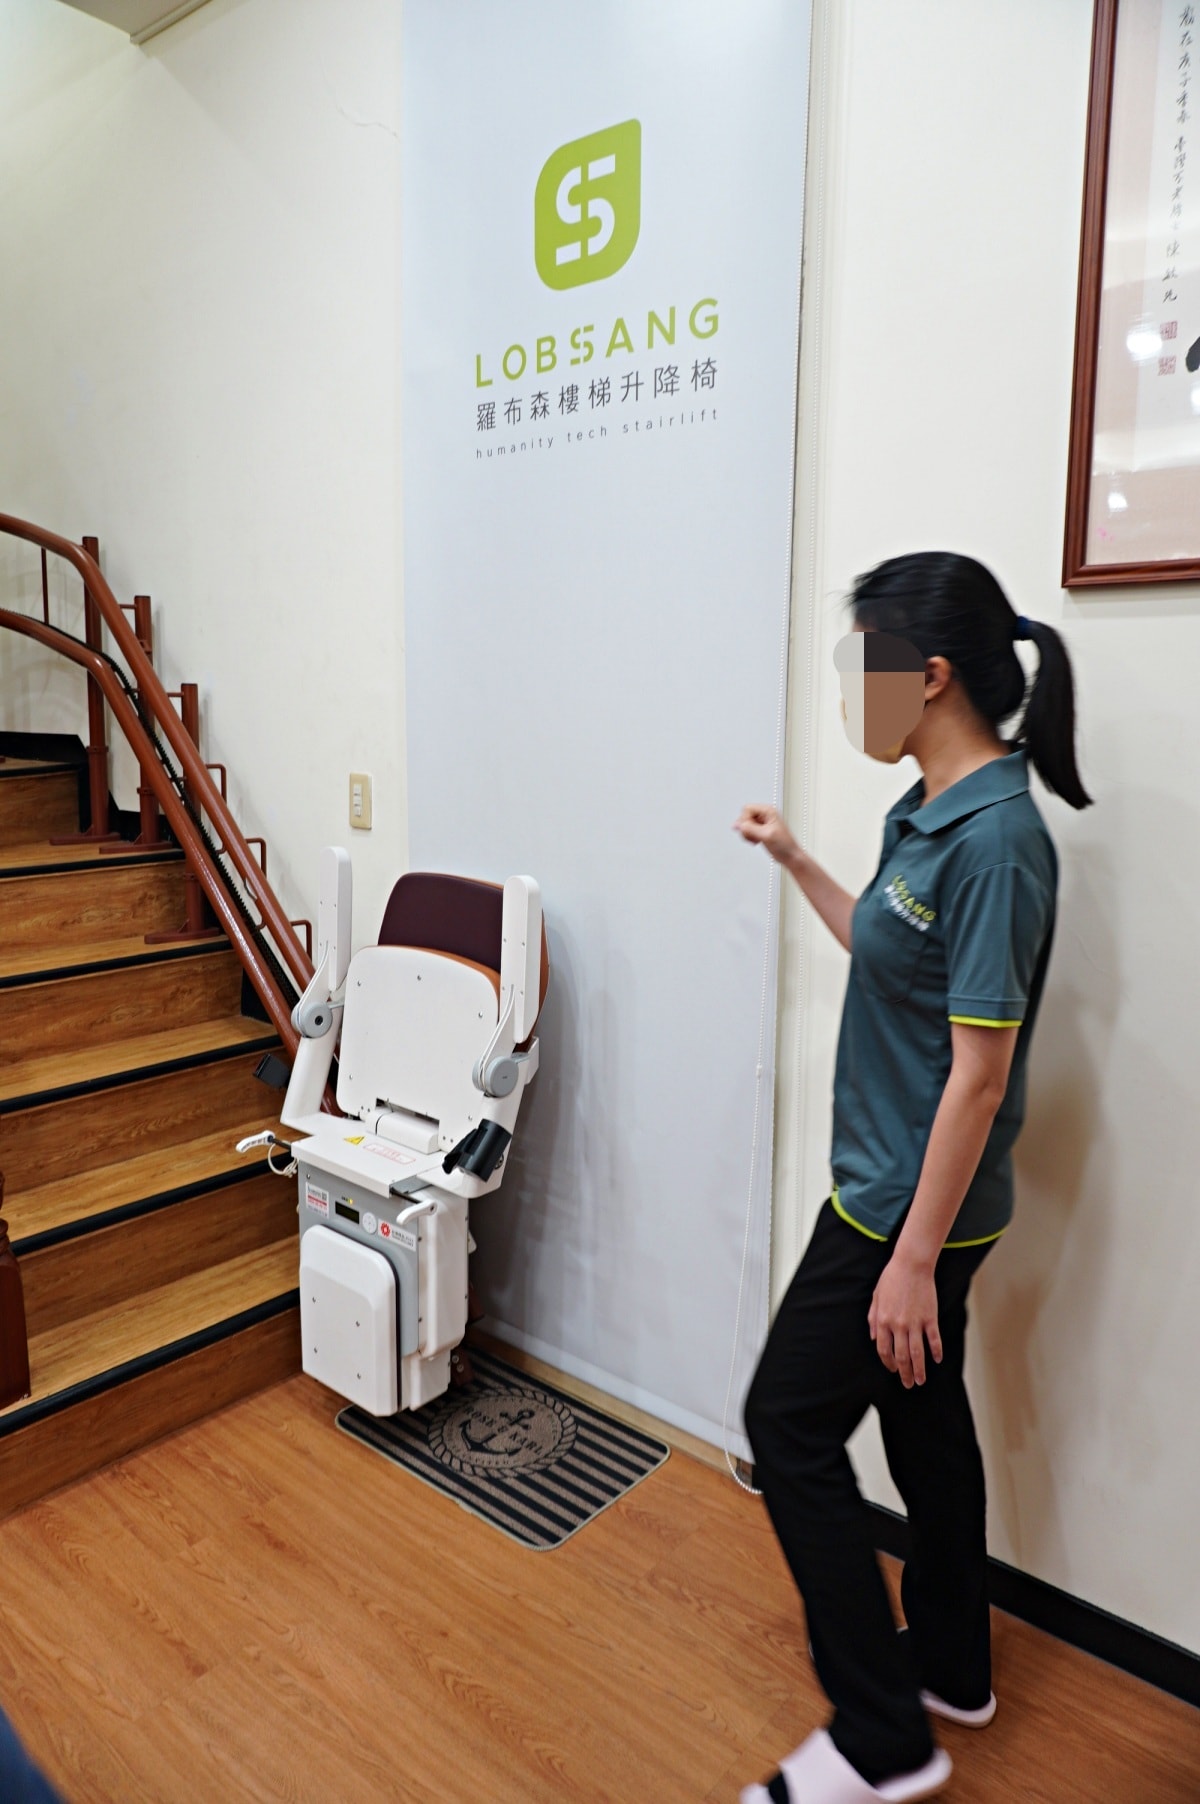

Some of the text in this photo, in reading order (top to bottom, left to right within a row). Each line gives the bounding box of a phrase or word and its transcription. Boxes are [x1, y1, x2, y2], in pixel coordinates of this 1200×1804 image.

[476, 297, 719, 388] LOBSANG
[476, 356, 718, 432] 羅布森樓梯升降椅
[476, 408, 718, 459] humanity tech stairlift
